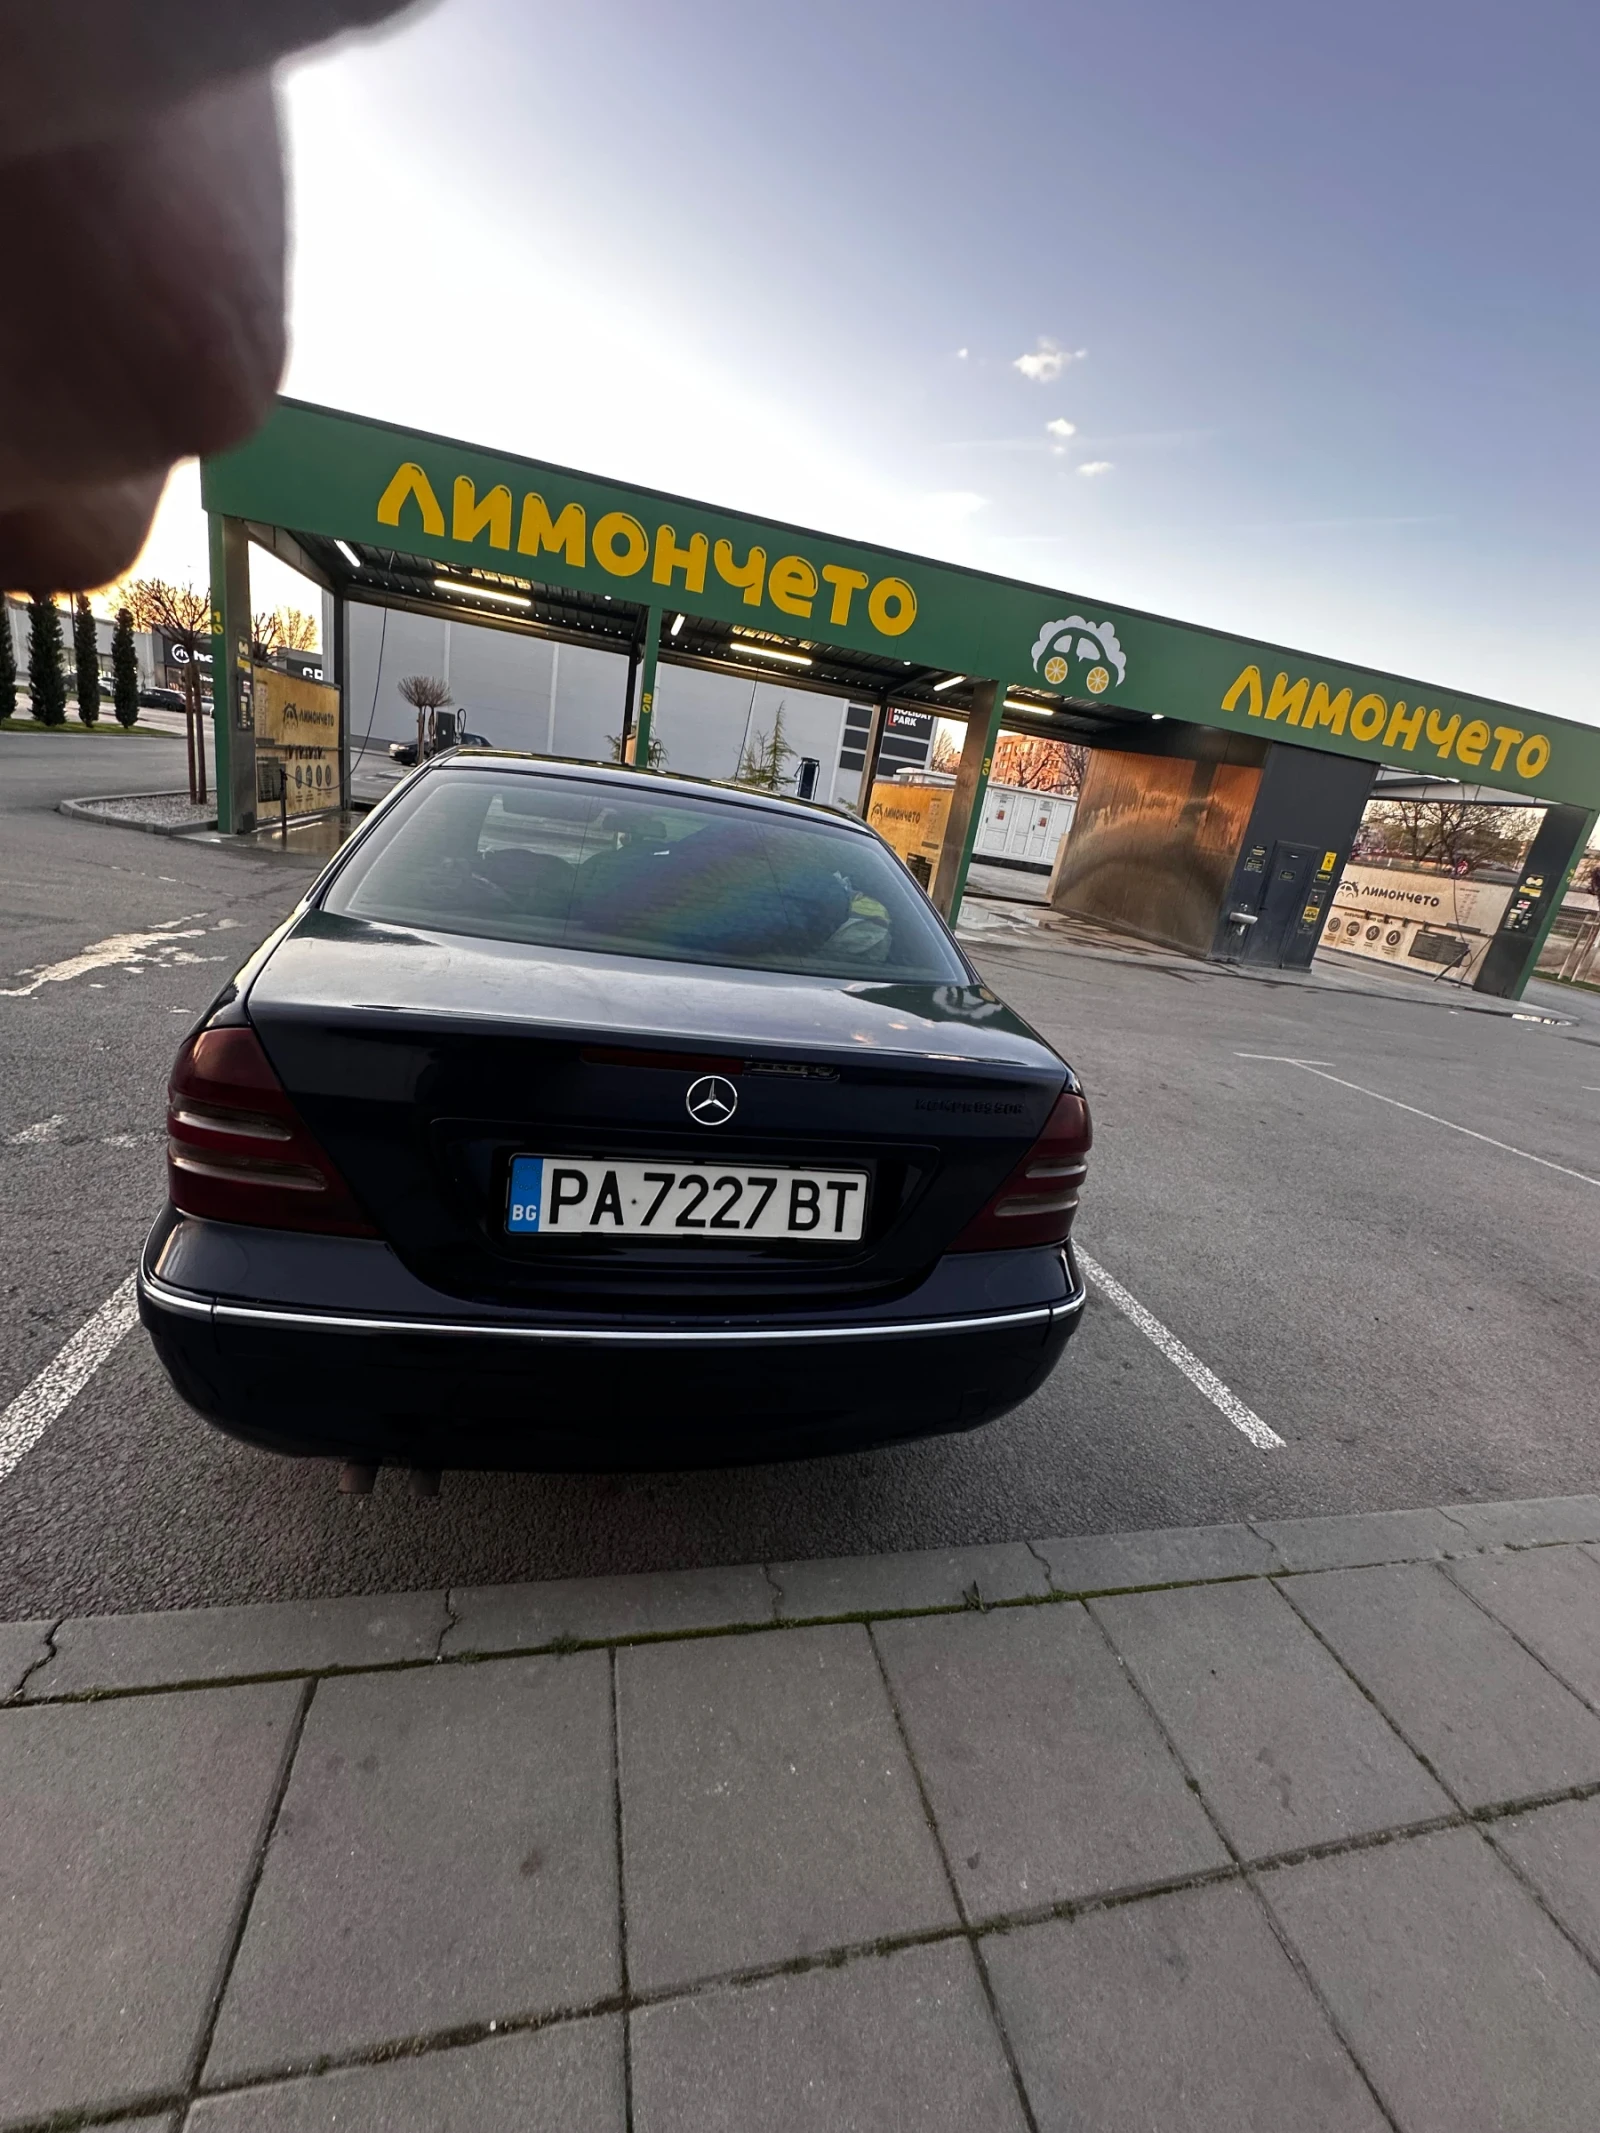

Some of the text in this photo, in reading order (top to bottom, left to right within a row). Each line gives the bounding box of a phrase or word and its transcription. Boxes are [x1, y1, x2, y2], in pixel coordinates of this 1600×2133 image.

[377, 462, 918, 637] Лимончето
[893, 714, 917, 727] PARK
[1220, 664, 1551, 779] Лимончето
[1361, 886, 1440, 908] Лимончето
[512, 1204, 537, 1221] BG
